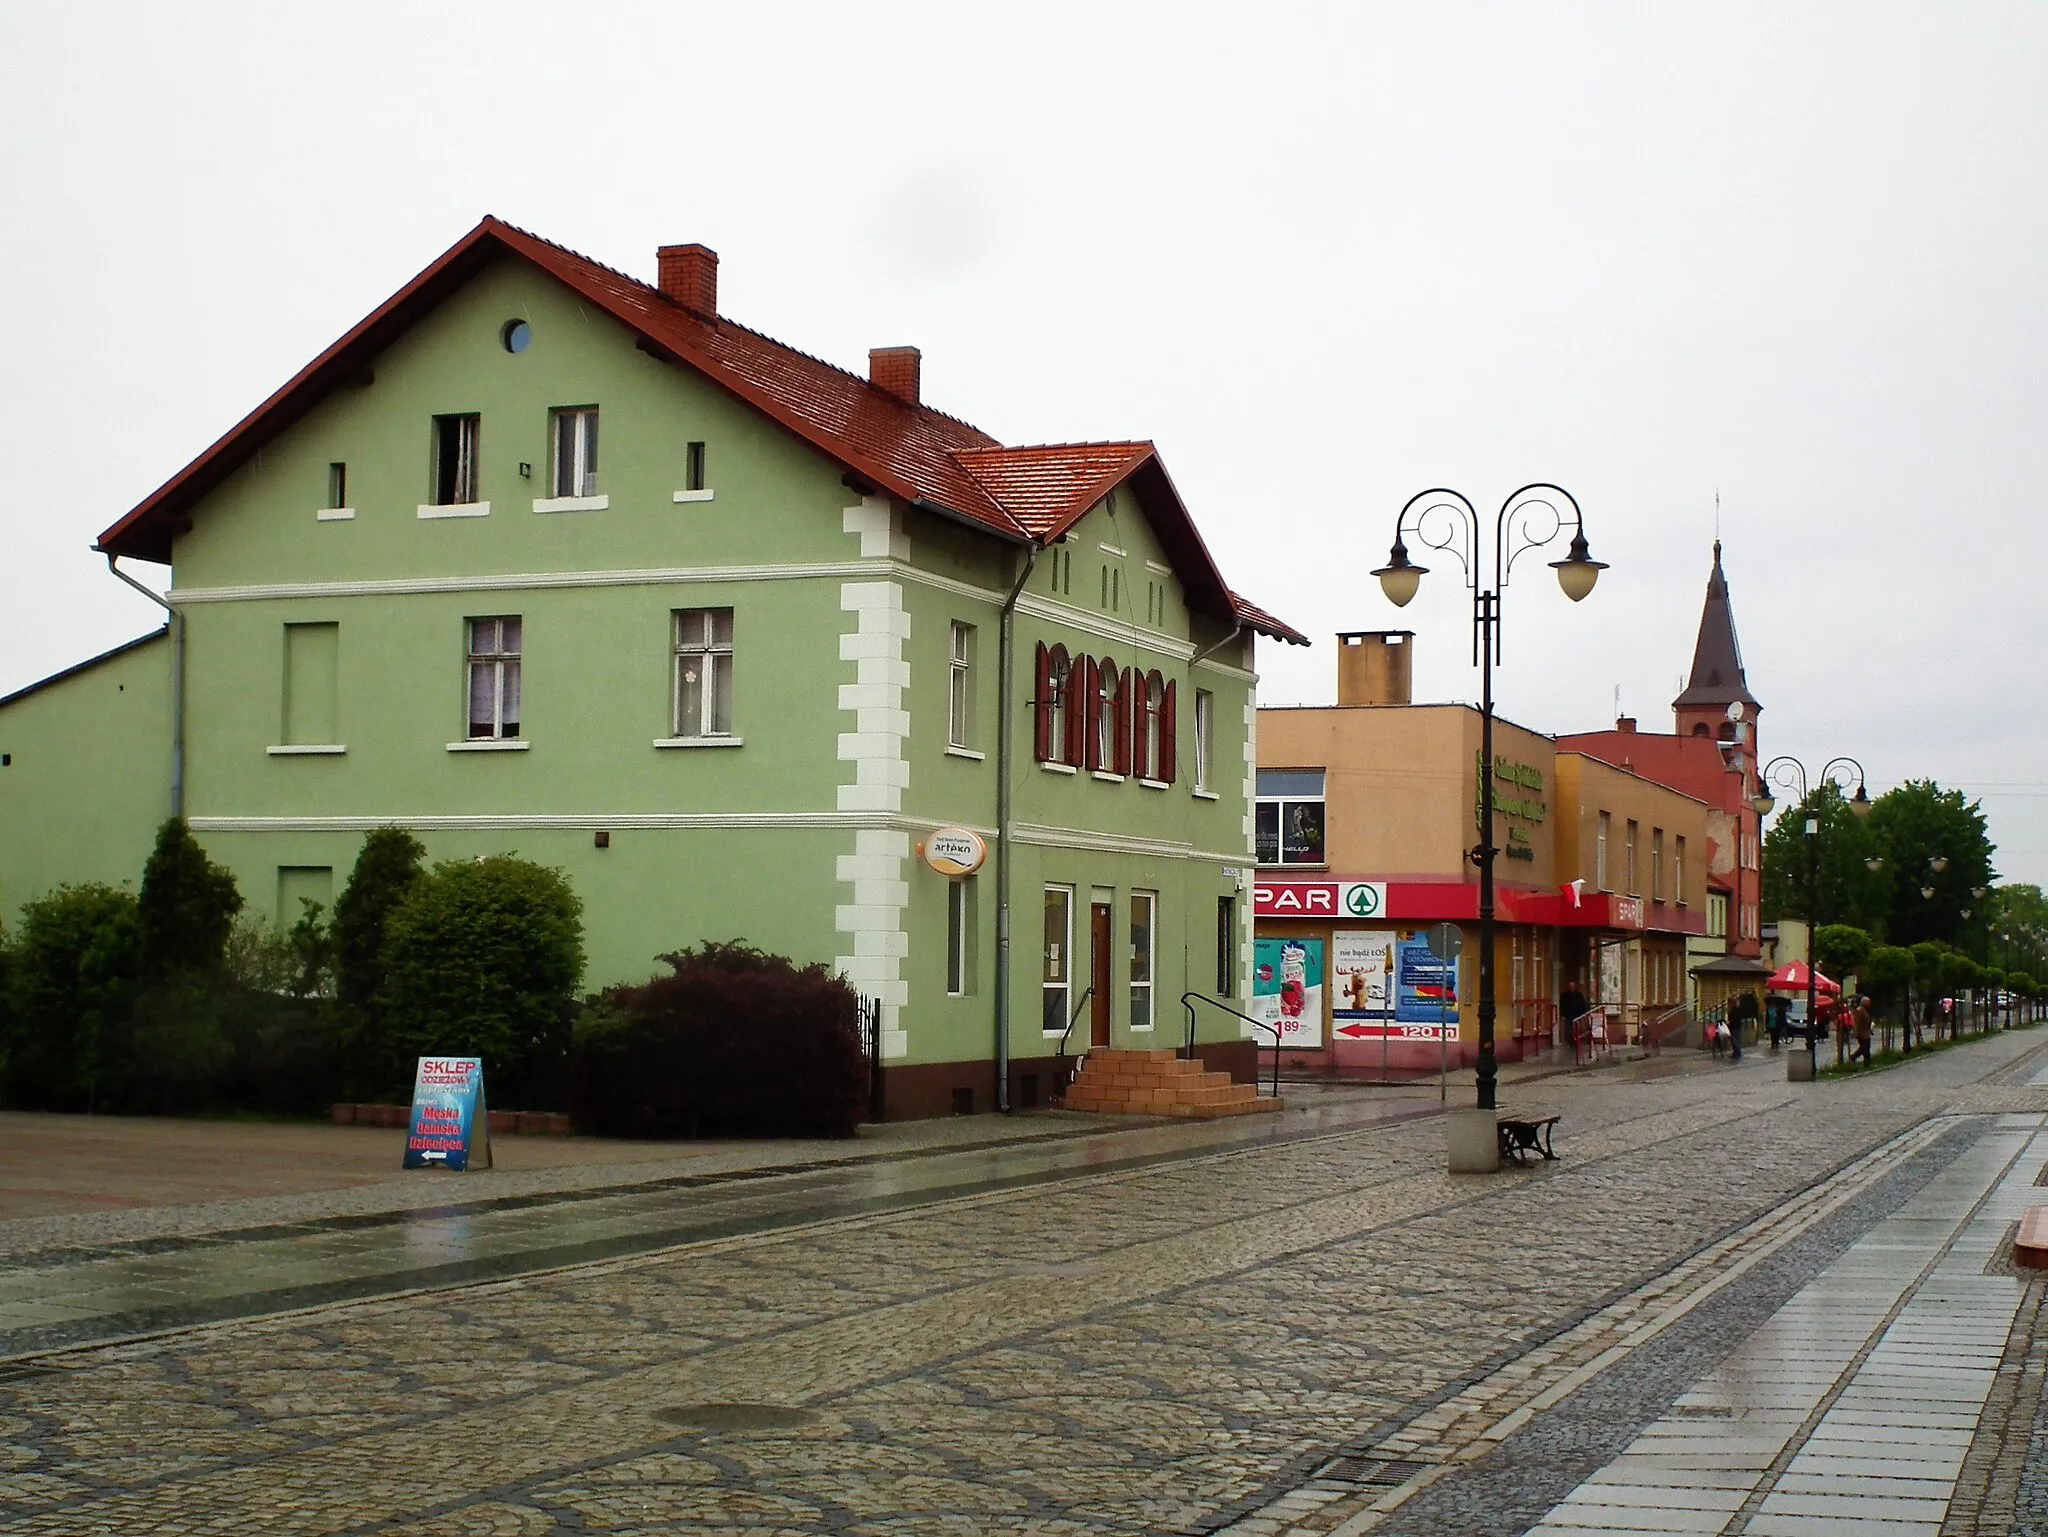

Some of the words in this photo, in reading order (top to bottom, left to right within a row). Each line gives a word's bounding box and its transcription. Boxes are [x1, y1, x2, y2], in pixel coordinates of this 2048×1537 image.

[1254, 889, 1331, 910] PAR
[1339, 948, 1351, 956] nie
[1400, 1025, 1433, 1038] 120
[1438, 1028, 1455, 1038] m
[423, 1061, 476, 1074] SKLEP
[420, 1075, 471, 1084] ODZIEŻOWY
[422, 1107, 460, 1122] Męska
[416, 1121, 461, 1136] Damska
[409, 1136, 464, 1152] Dziecięca
